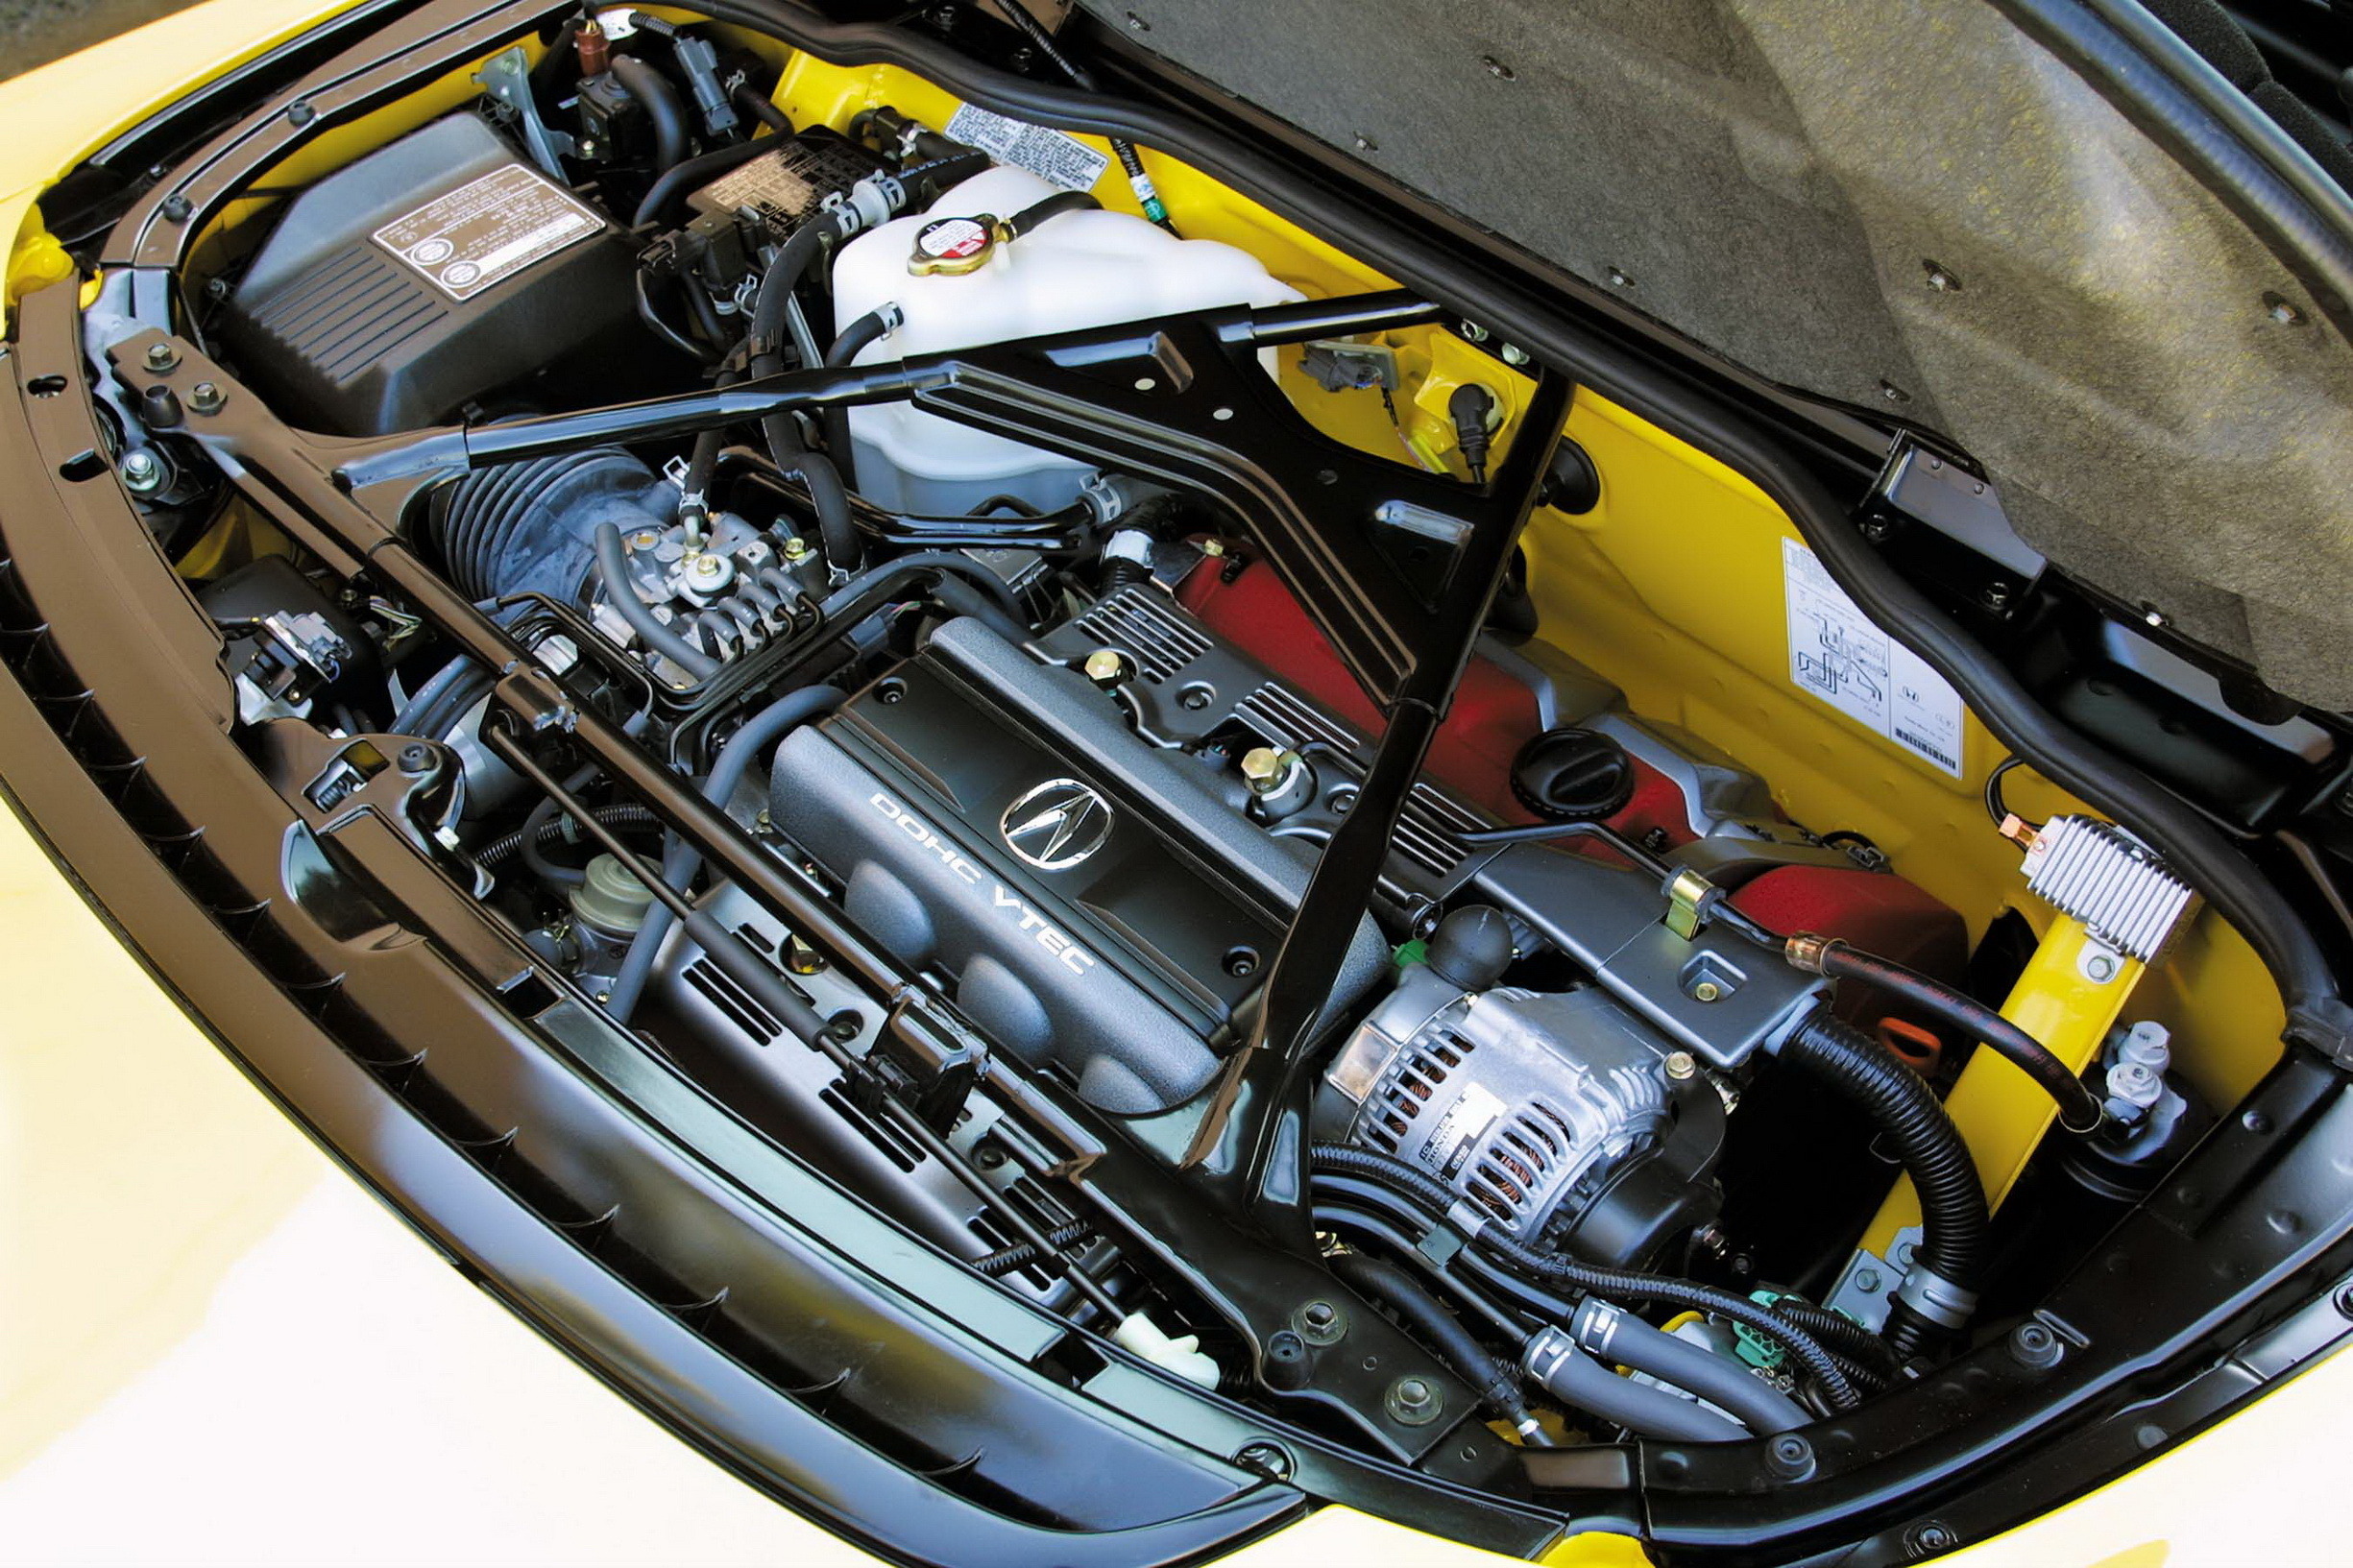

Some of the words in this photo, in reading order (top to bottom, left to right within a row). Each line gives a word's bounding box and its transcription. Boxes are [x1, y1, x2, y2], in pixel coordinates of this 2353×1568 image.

[868, 793, 982, 885] DOHC
[993, 884, 1096, 976] VTEC
[1426, 1123, 1455, 1164] HONDA
